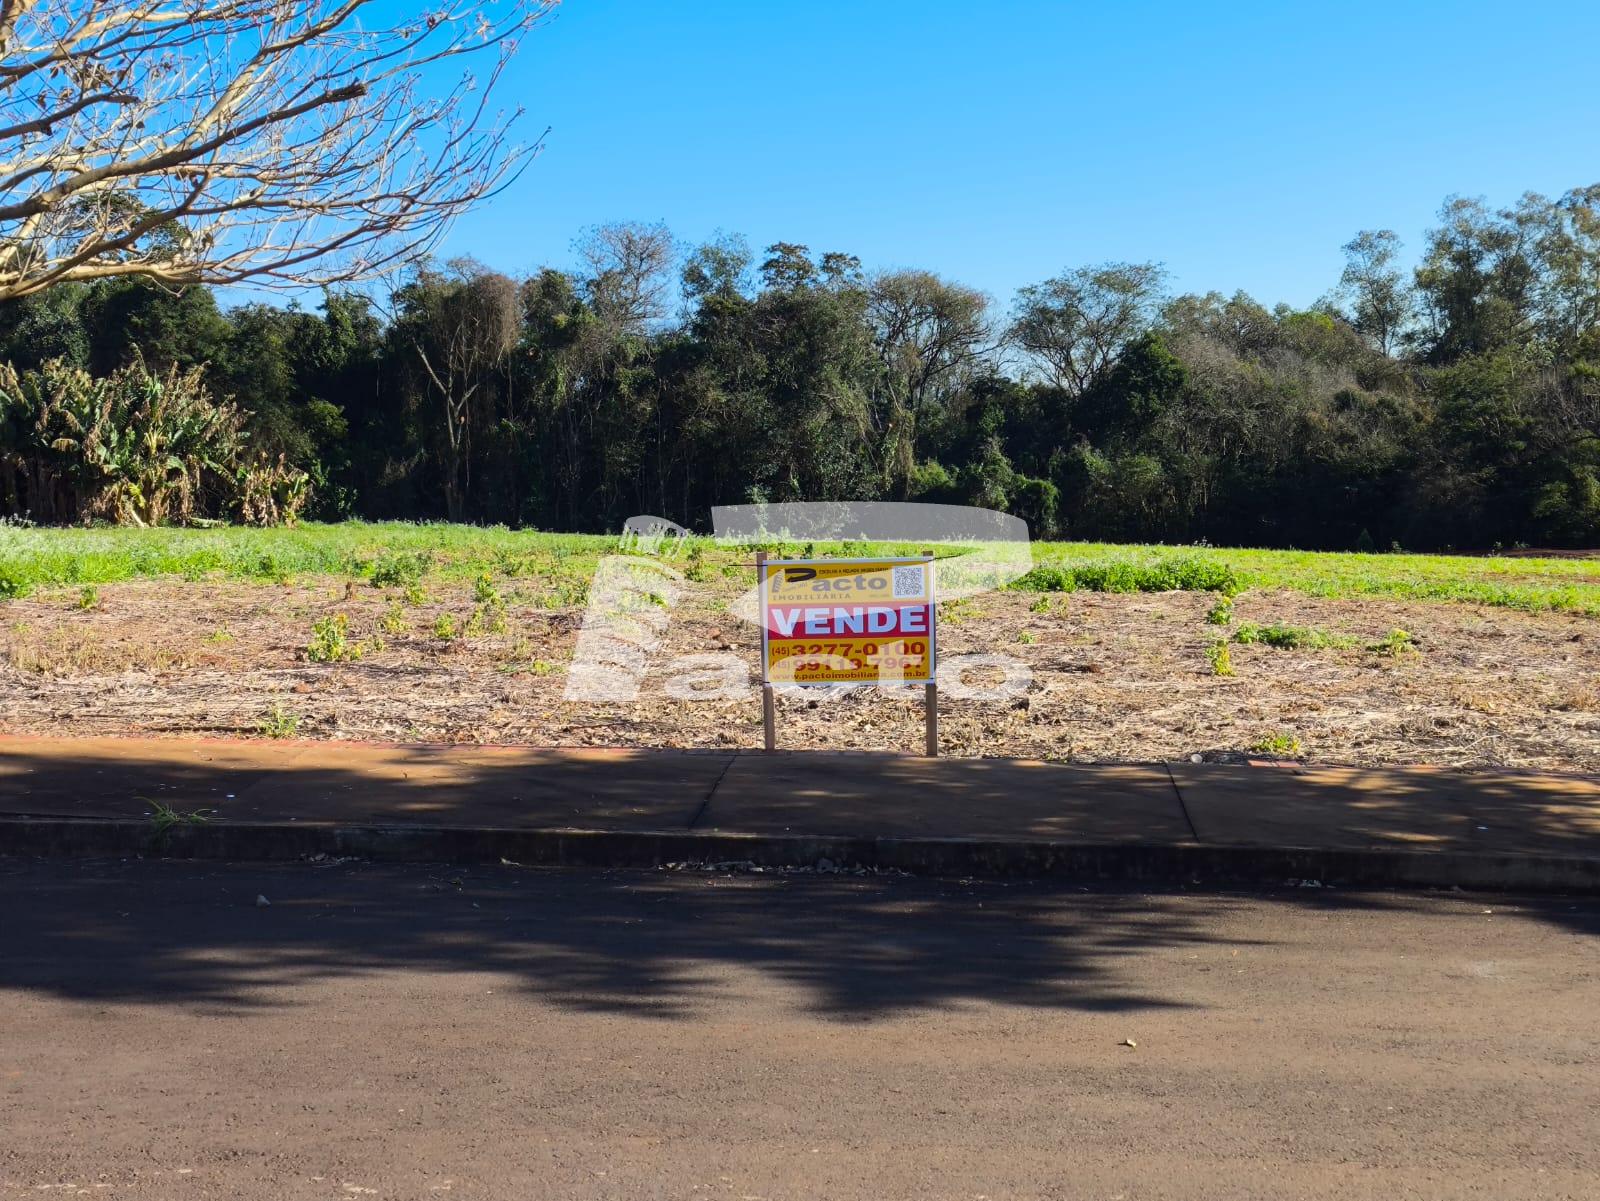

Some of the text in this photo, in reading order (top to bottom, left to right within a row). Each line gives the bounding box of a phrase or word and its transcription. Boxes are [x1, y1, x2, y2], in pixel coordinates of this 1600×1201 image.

[772, 568, 887, 592] Pacto
[772, 606, 925, 636] VENDE
[772, 642, 925, 657] (45) 3277-0100
